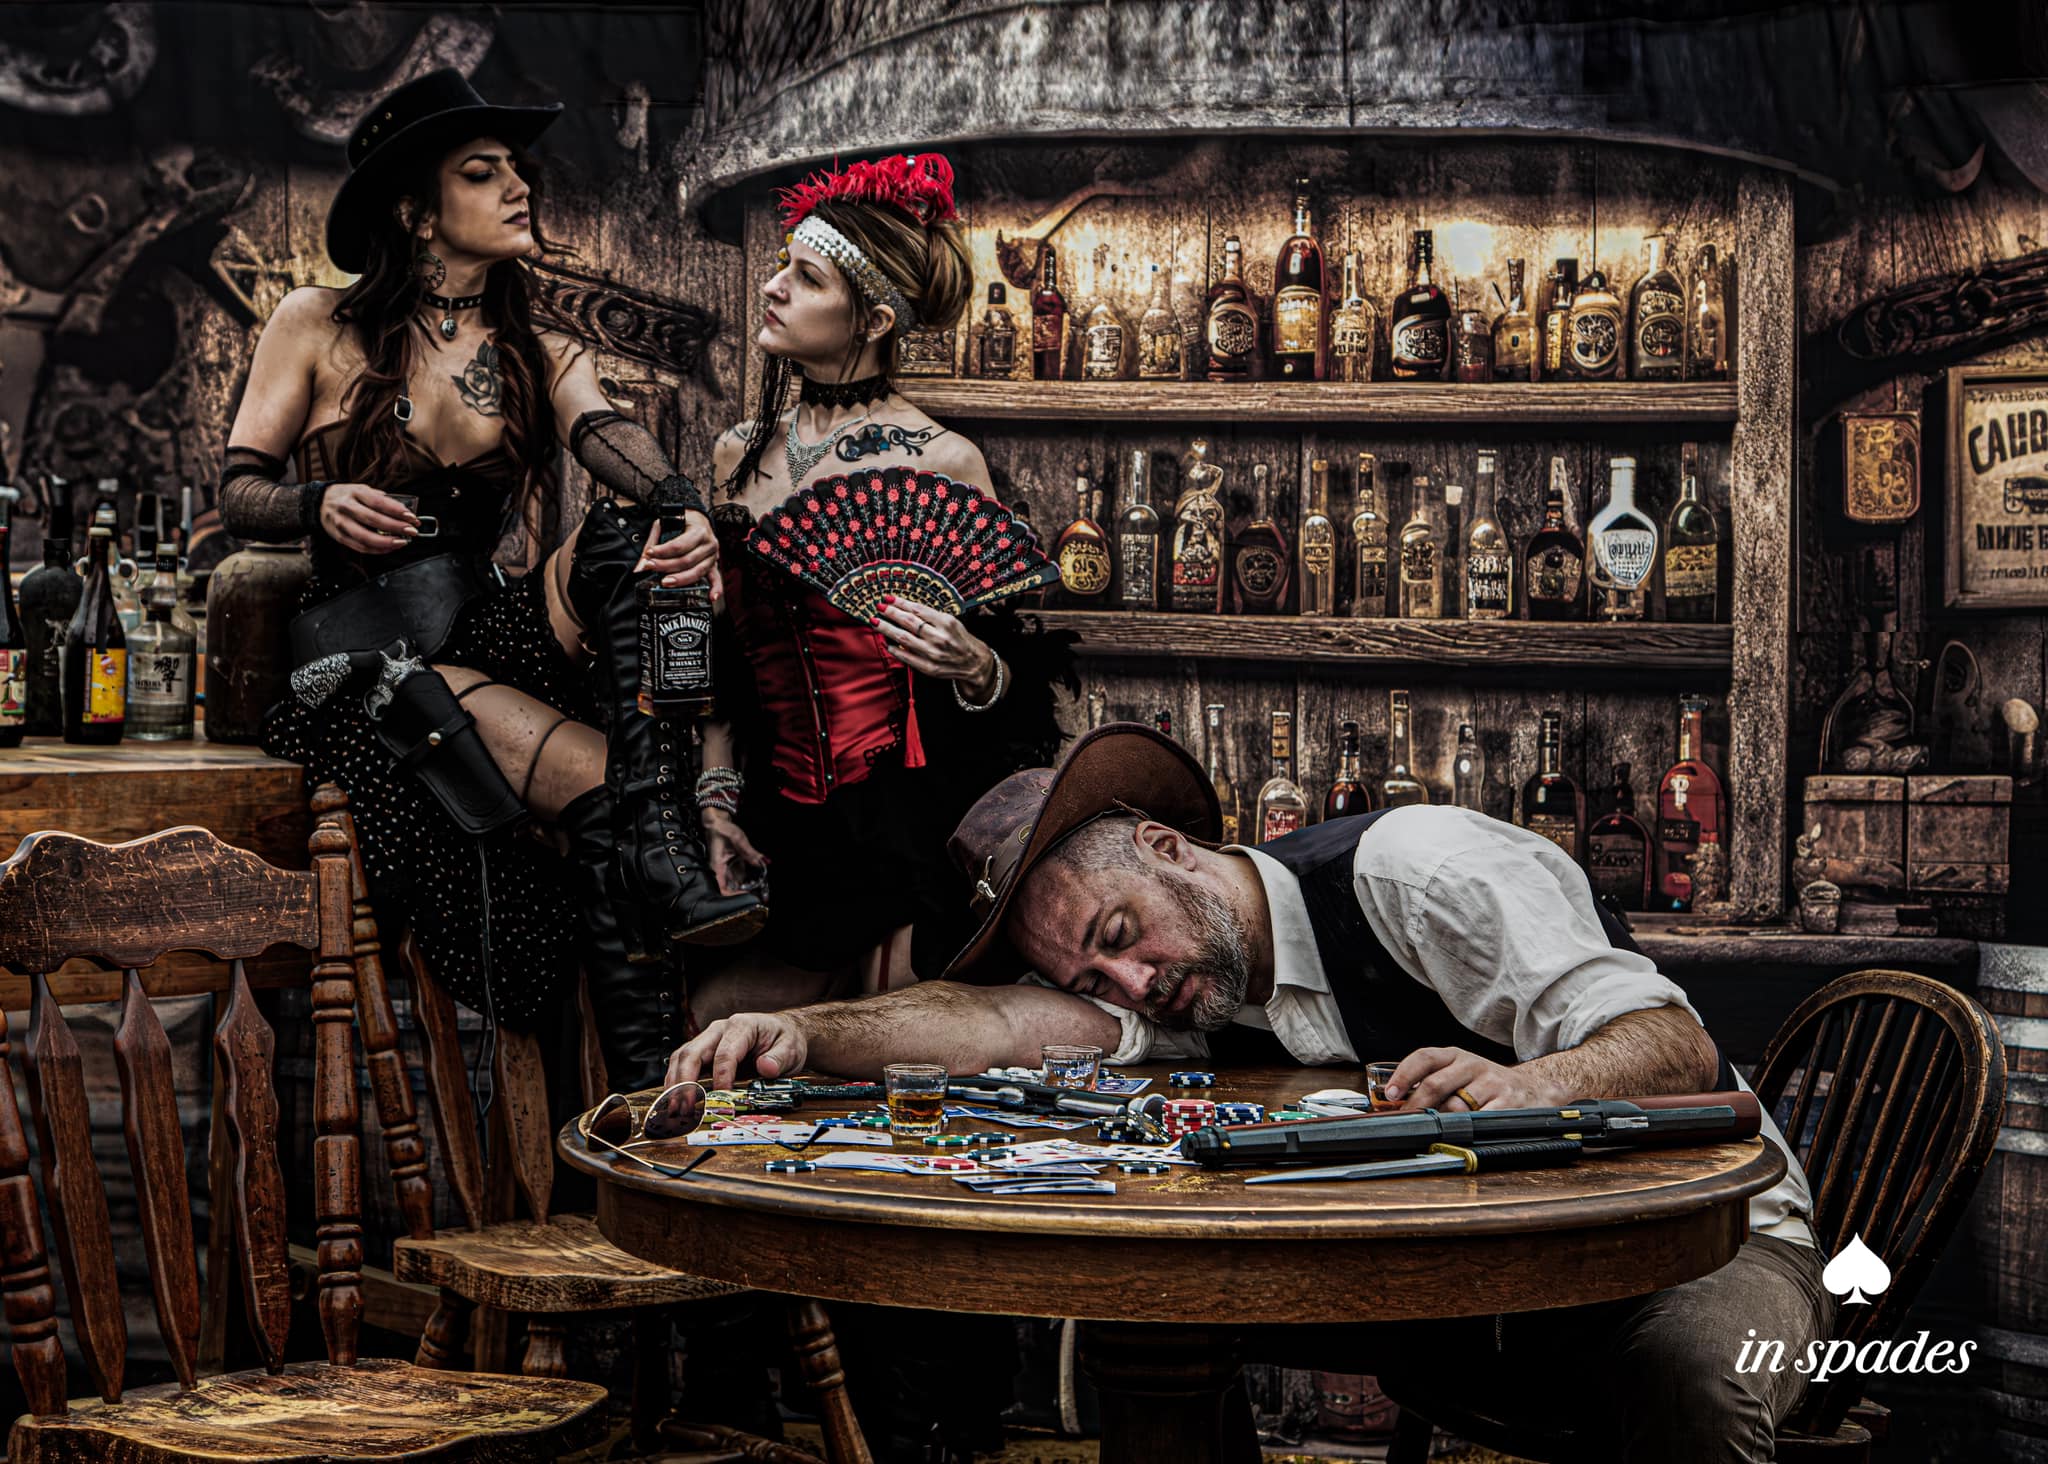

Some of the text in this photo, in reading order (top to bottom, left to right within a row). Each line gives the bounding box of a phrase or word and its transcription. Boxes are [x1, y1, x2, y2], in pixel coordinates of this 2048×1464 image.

[659, 615, 710, 636] JACK DANIEL'S
[669, 659, 702, 667] WHISKEY
